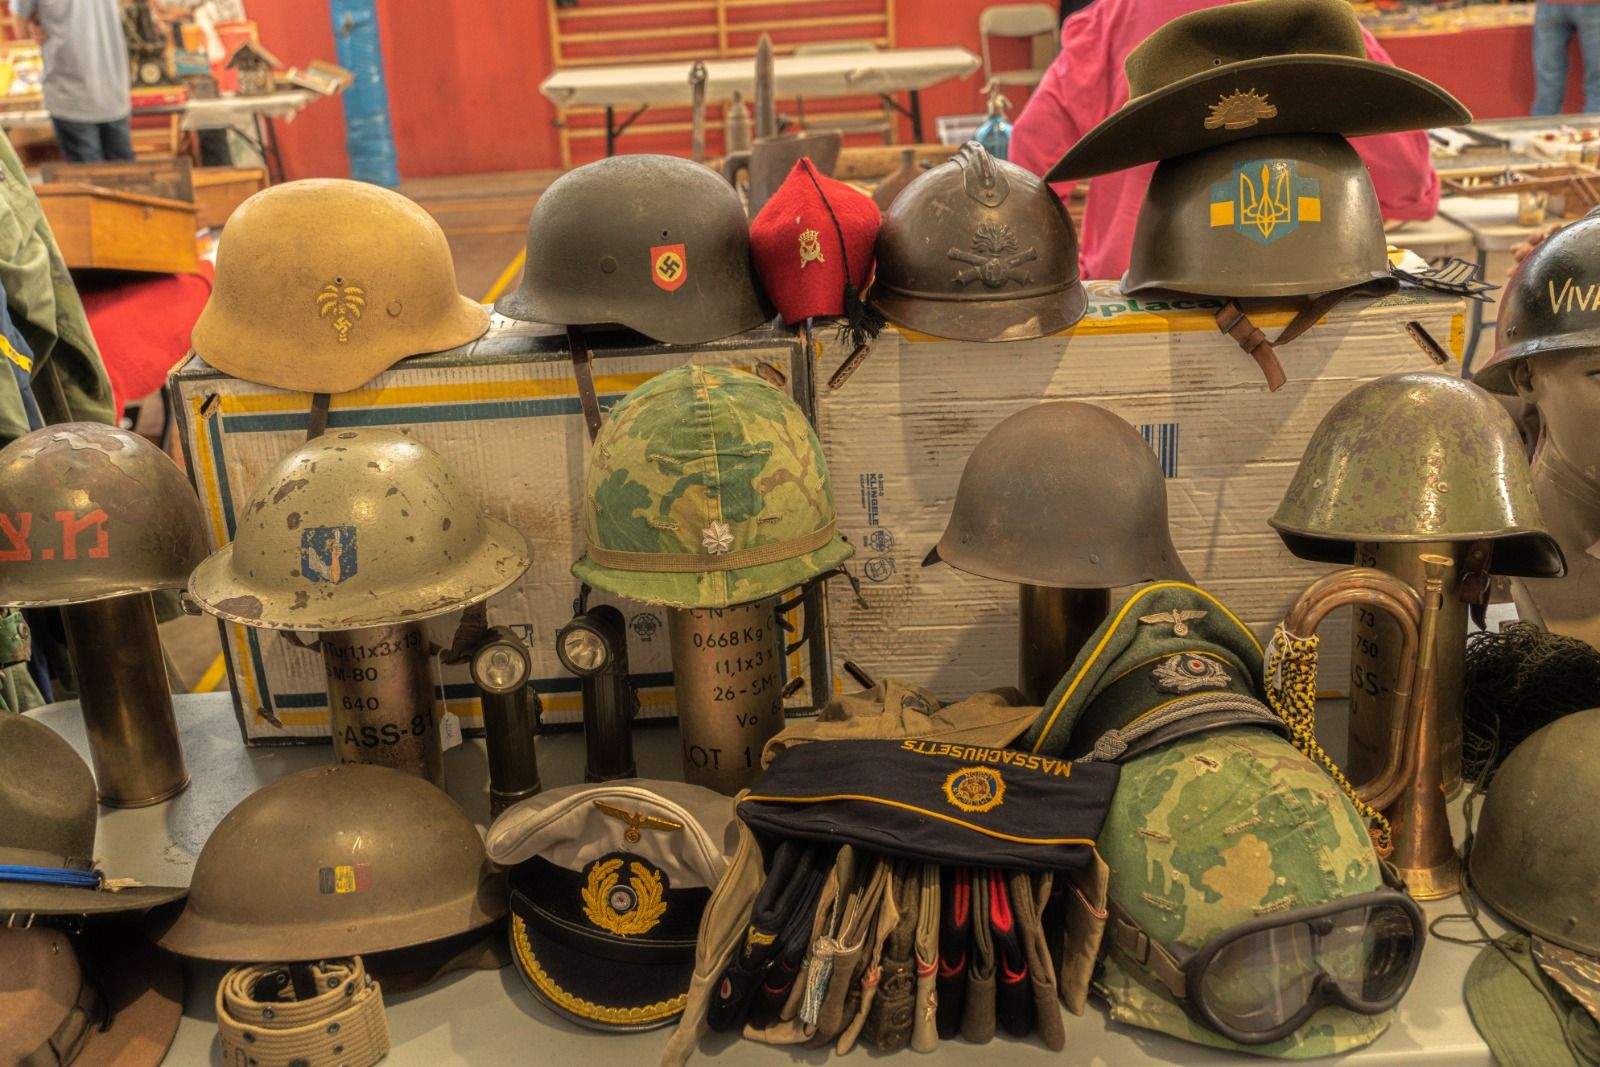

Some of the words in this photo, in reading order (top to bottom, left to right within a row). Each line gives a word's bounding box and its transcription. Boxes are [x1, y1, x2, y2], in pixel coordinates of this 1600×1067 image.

[870, 473, 879, 526] KLINGELE
[342, 696, 379, 711] 640
[901, 740, 1073, 778] MASSACHUSETTS
